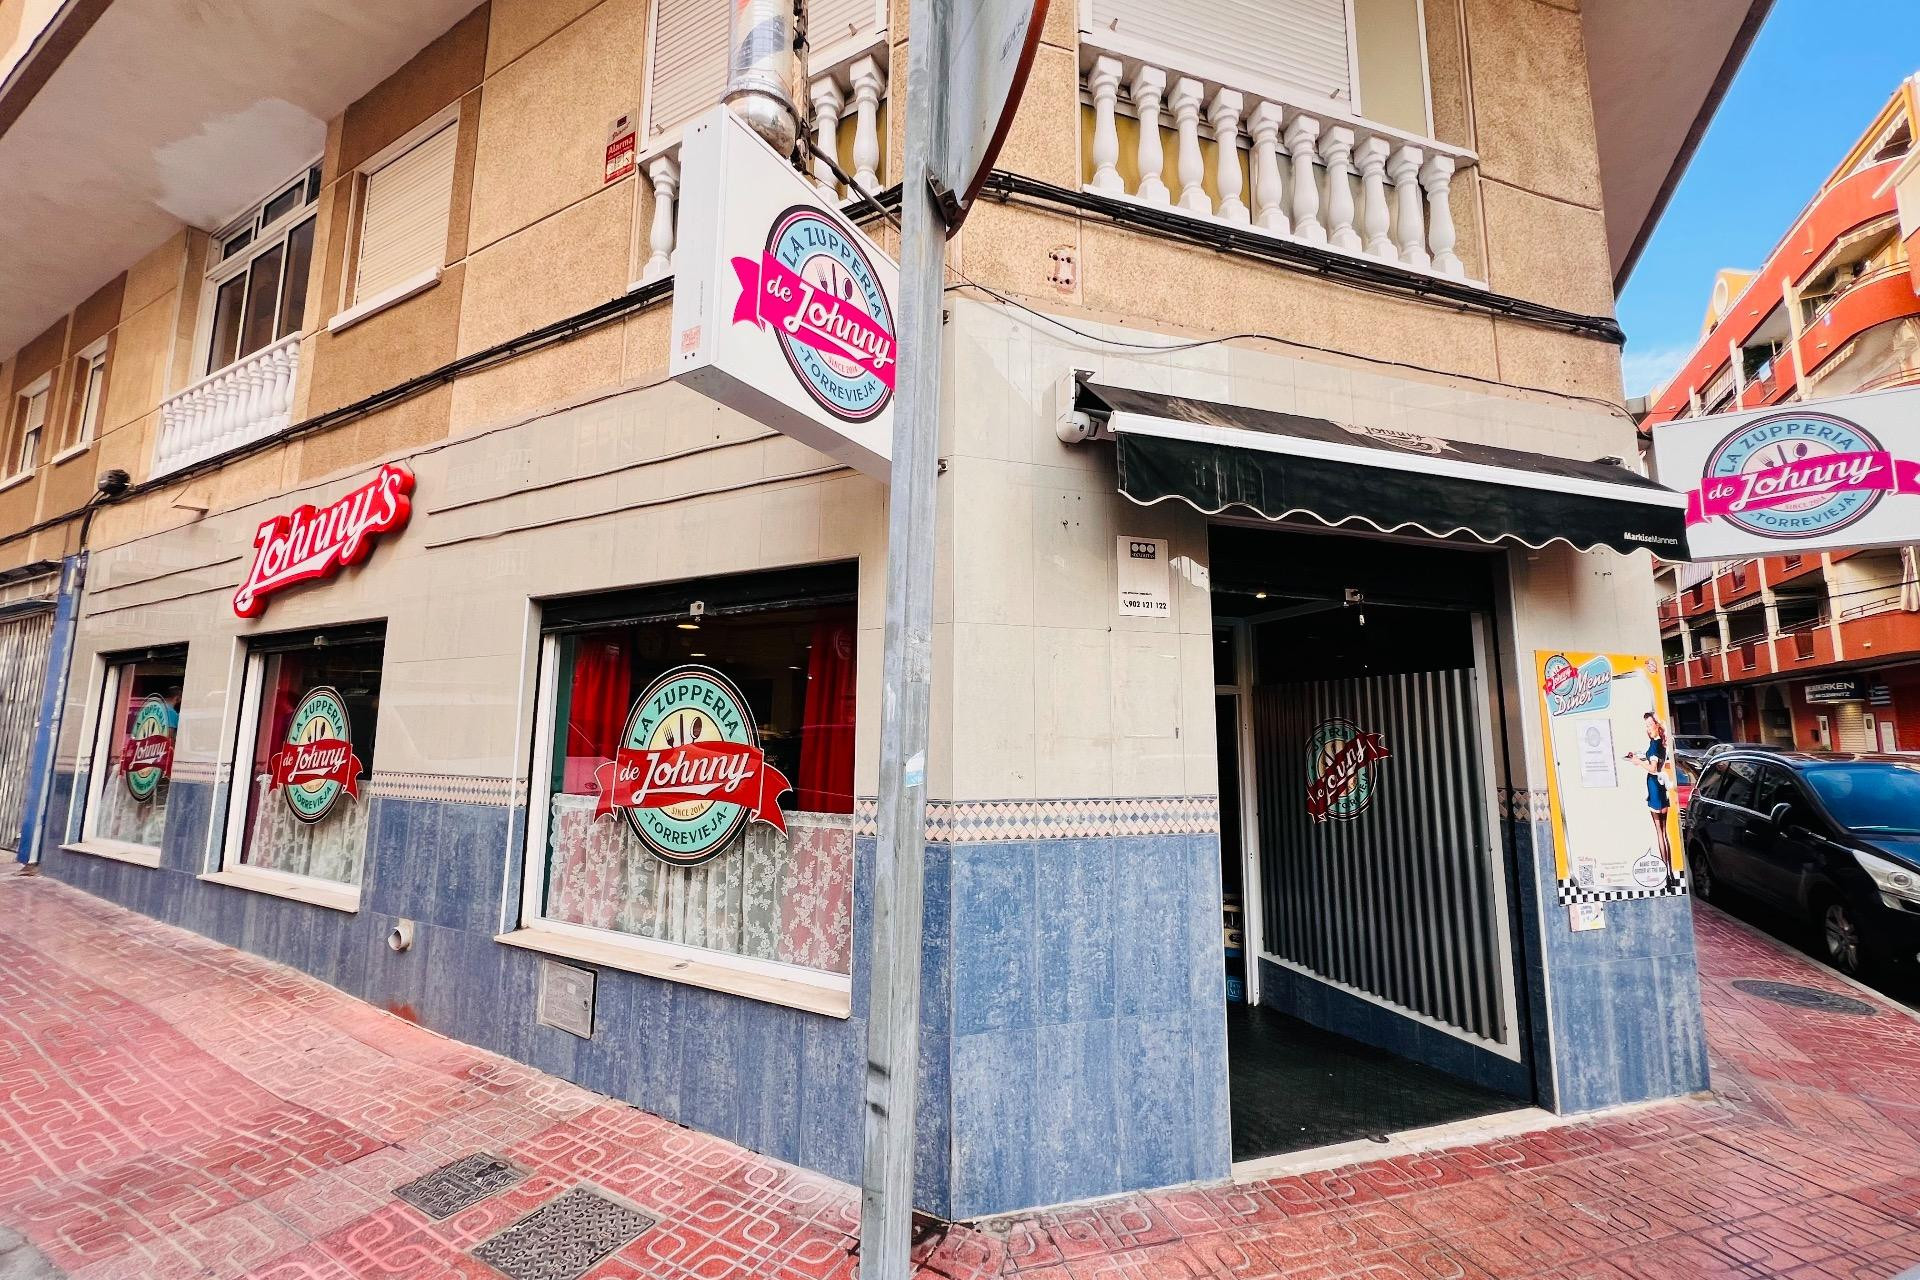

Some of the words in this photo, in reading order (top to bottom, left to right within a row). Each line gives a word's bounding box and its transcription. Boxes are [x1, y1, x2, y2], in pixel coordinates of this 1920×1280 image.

[609, 137, 633, 154] Alarma
[783, 236, 804, 270] LA
[804, 227, 882, 319] ZUPPERIA
[766, 275, 792, 303] de
[784, 283, 894, 369] Johnny
[1720, 453, 1742, 474] LA
[1740, 423, 1856, 450] ZUPPERIA
[1708, 484, 1735, 500] de
[1728, 456, 1884, 511] Johnny
[235, 470, 400, 612] Johnny's
[1624, 531, 1678, 545] MarkiseMannen
[1128, 600, 1141, 608] 902
[1156, 602, 1167, 610] 122
[1576, 671, 1611, 696] Menu
[292, 723, 303, 742] LA
[303, 701, 343, 736] ZUPPERIA
[634, 717, 653, 747] LA
[653, 684, 739, 739] ZUPPERIA
[1553, 692, 1592, 716] Diner
[129, 741, 167, 770] Johnny
[282, 752, 294, 766] de
[288, 745, 348, 782] Johnny
[620, 760, 640, 782] de
[631, 751, 754, 805] Johnny
[671, 806, 690, 817] SINCE
[690, 803, 704, 816] 2014
